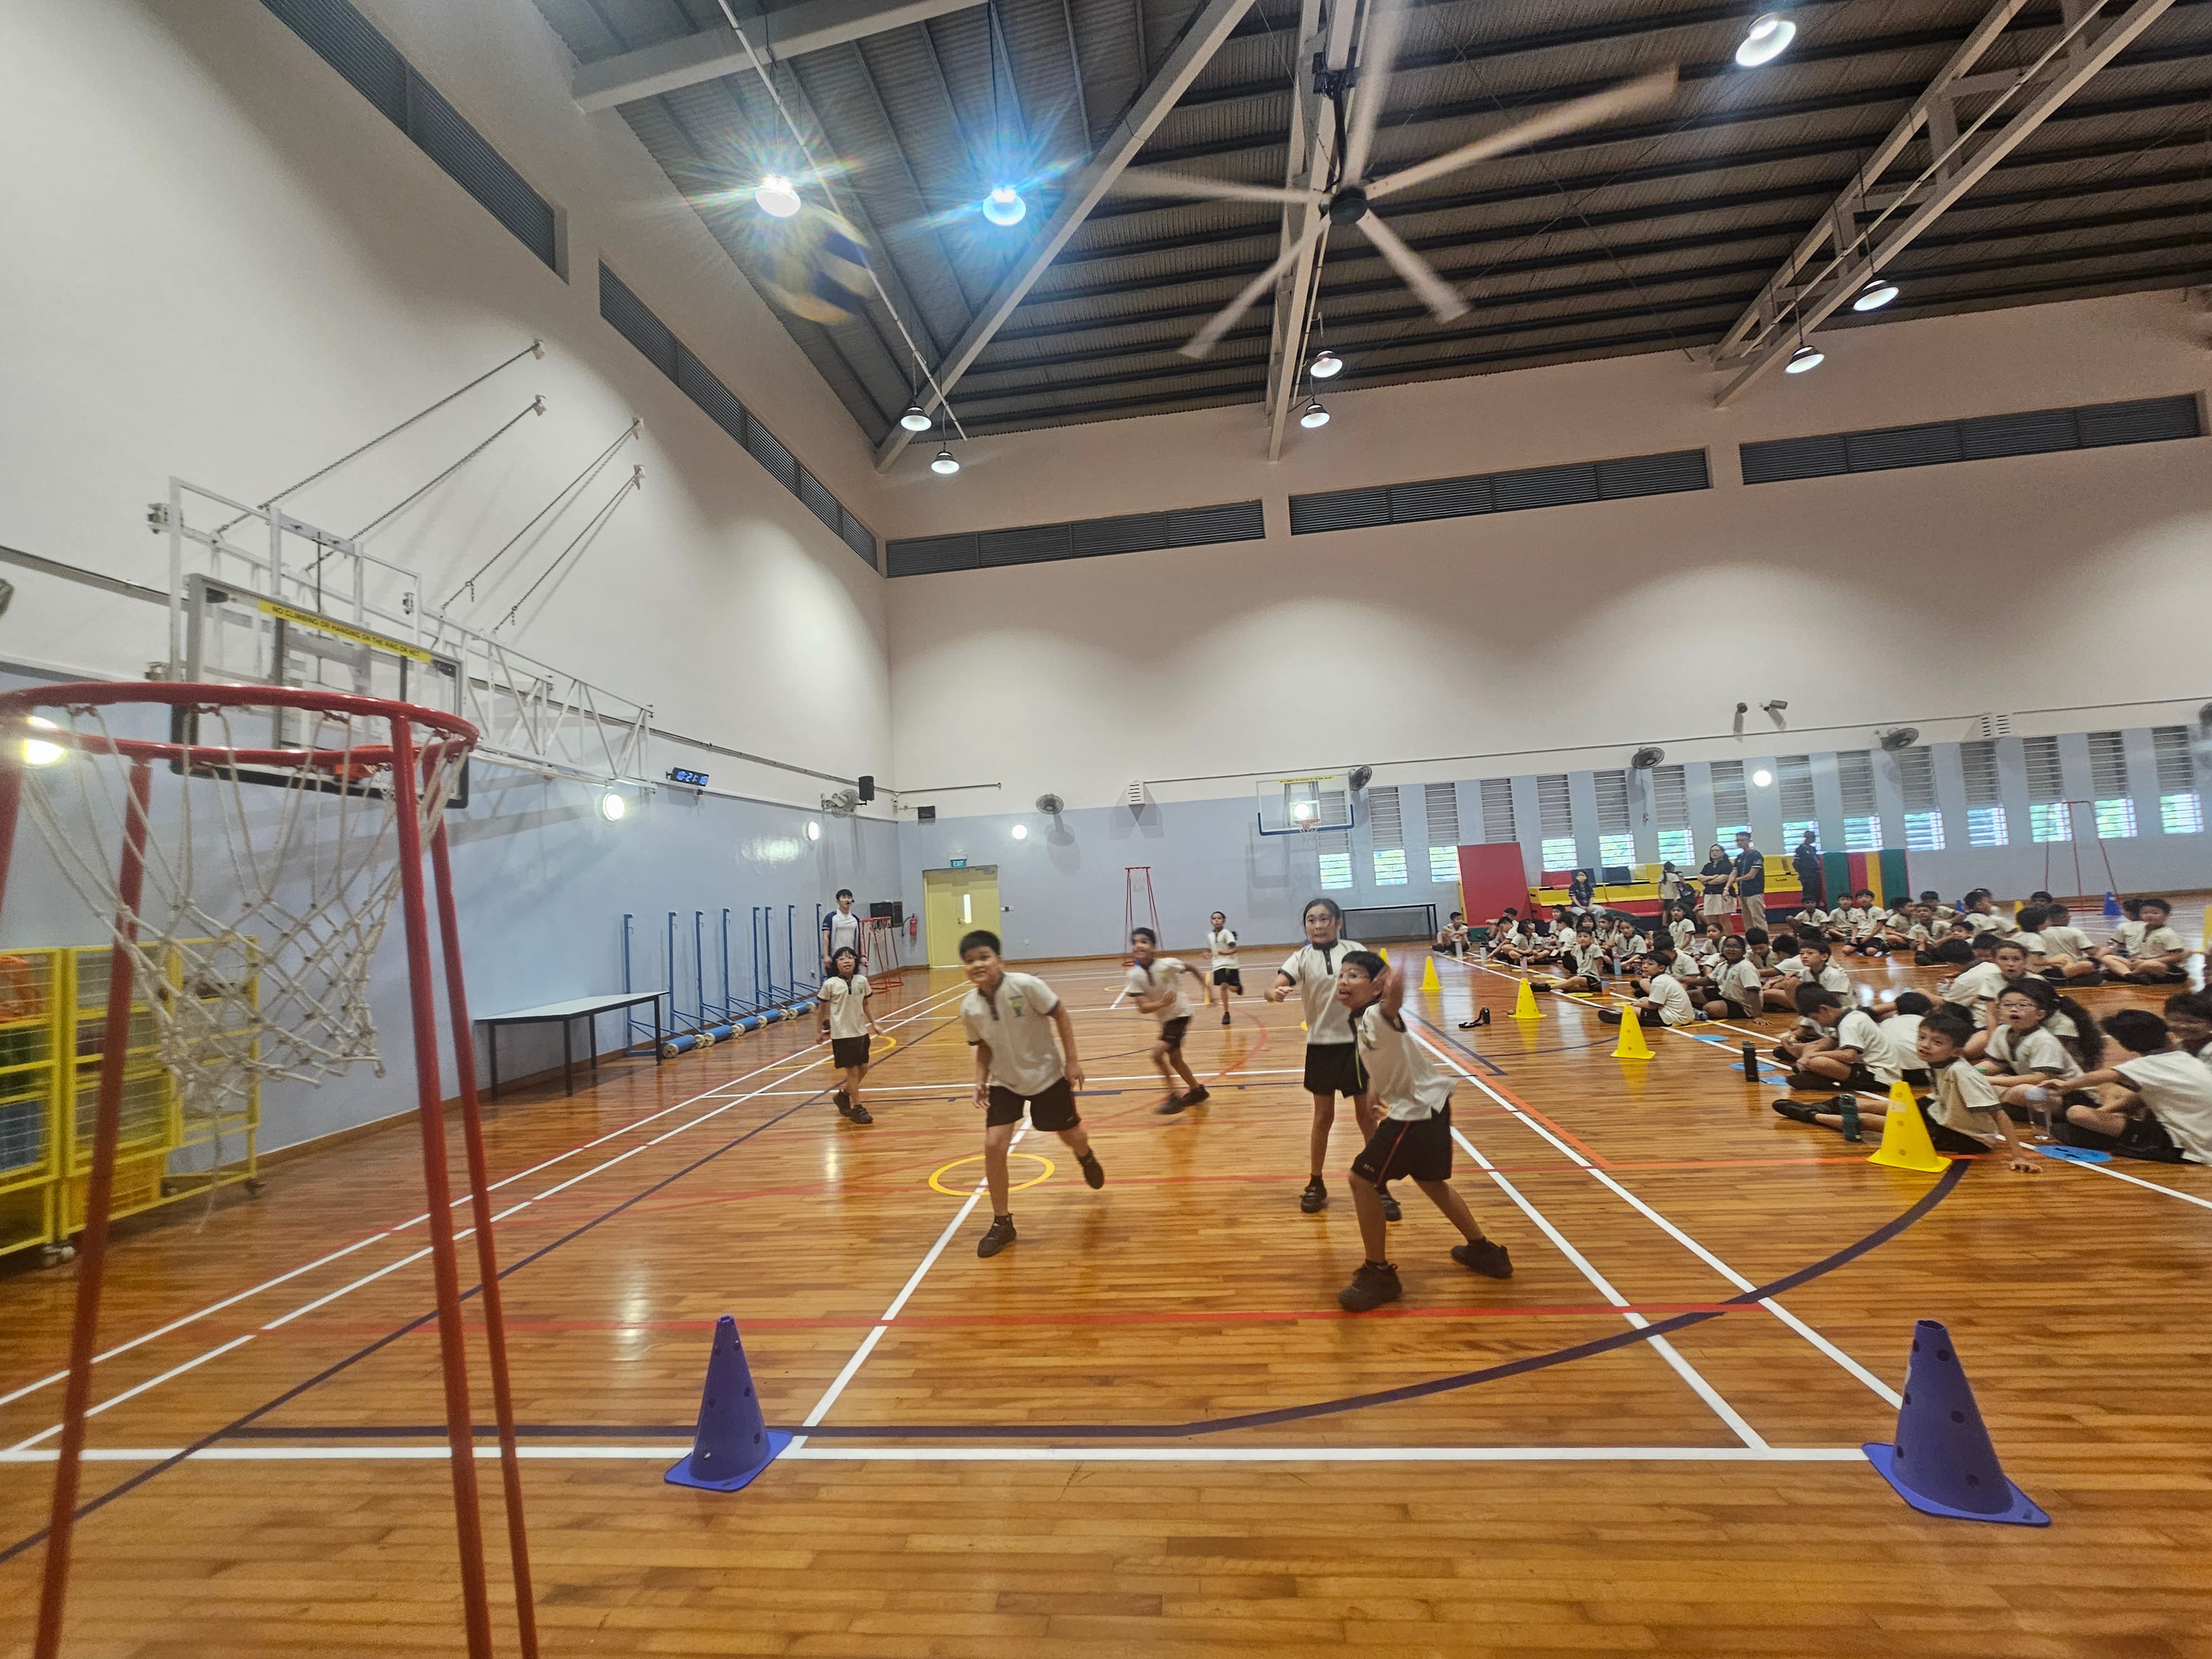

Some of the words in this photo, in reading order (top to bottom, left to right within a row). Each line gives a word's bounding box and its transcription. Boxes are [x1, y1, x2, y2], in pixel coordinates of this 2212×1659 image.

[273, 606, 283, 614] NO
[285, 609, 319, 625] CLIMBING
[332, 626, 361, 638] HANGING
[372, 637, 384, 645] THE
[385, 641, 399, 650] RING
